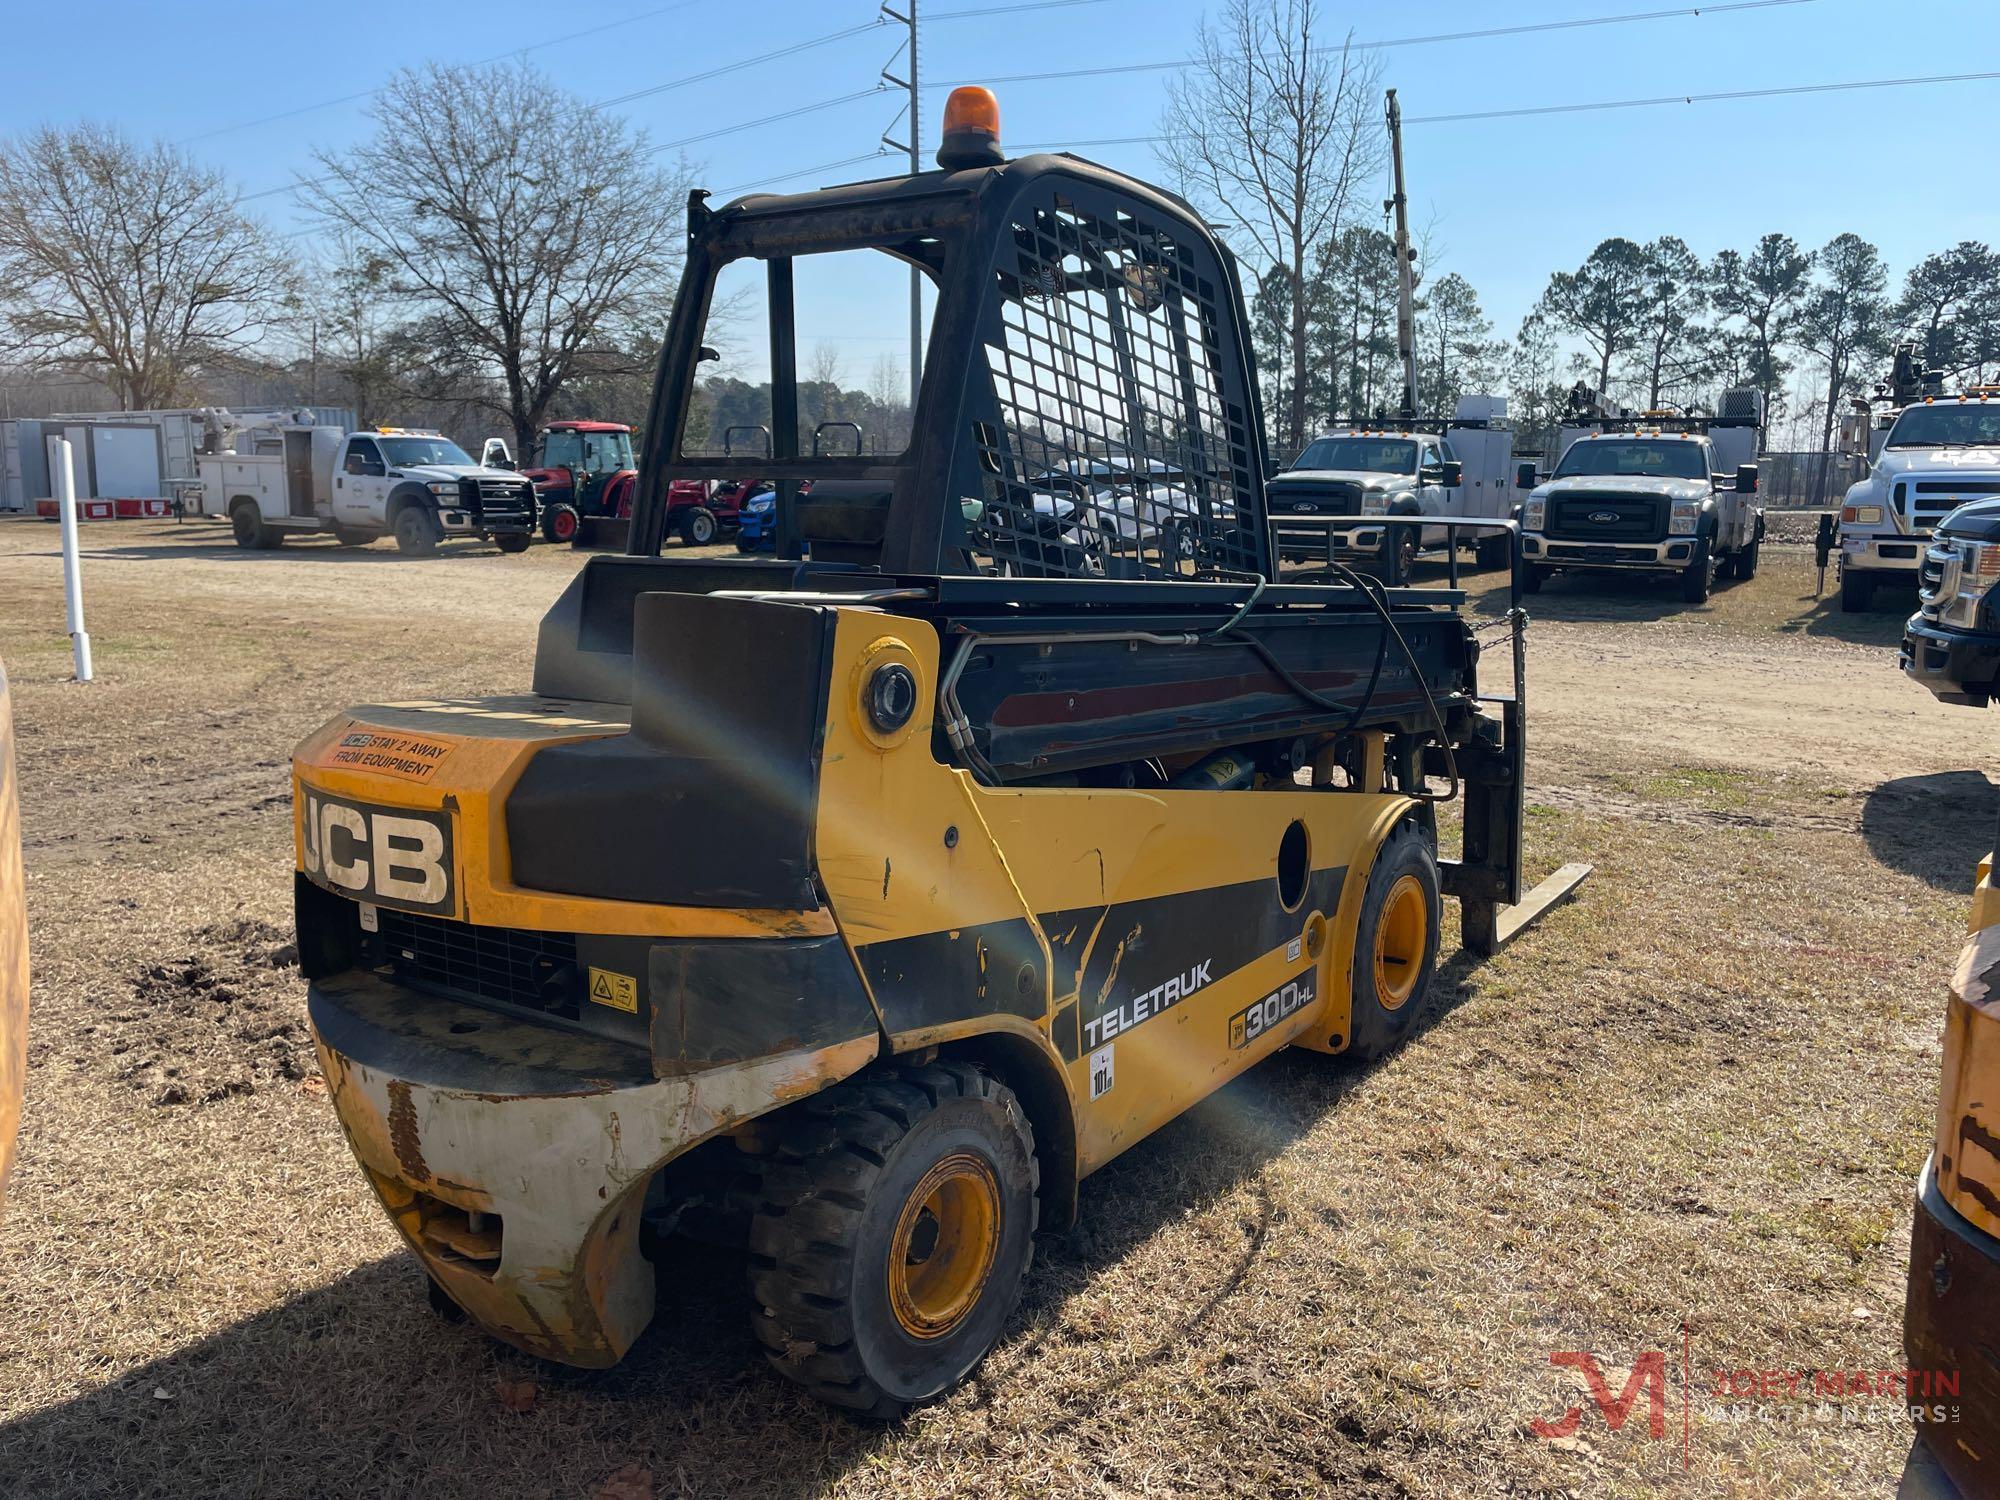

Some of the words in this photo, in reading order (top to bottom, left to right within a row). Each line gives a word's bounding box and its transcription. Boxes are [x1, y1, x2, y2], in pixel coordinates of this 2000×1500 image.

[333, 751, 361, 764] FROM
[362, 753, 434, 777] EQUIPMENT
[369, 737, 398, 752] STAY
[407, 742, 448, 760] AWAY
[303, 795, 448, 904] JCB
[1084, 958, 1213, 1048] TELETRUK
